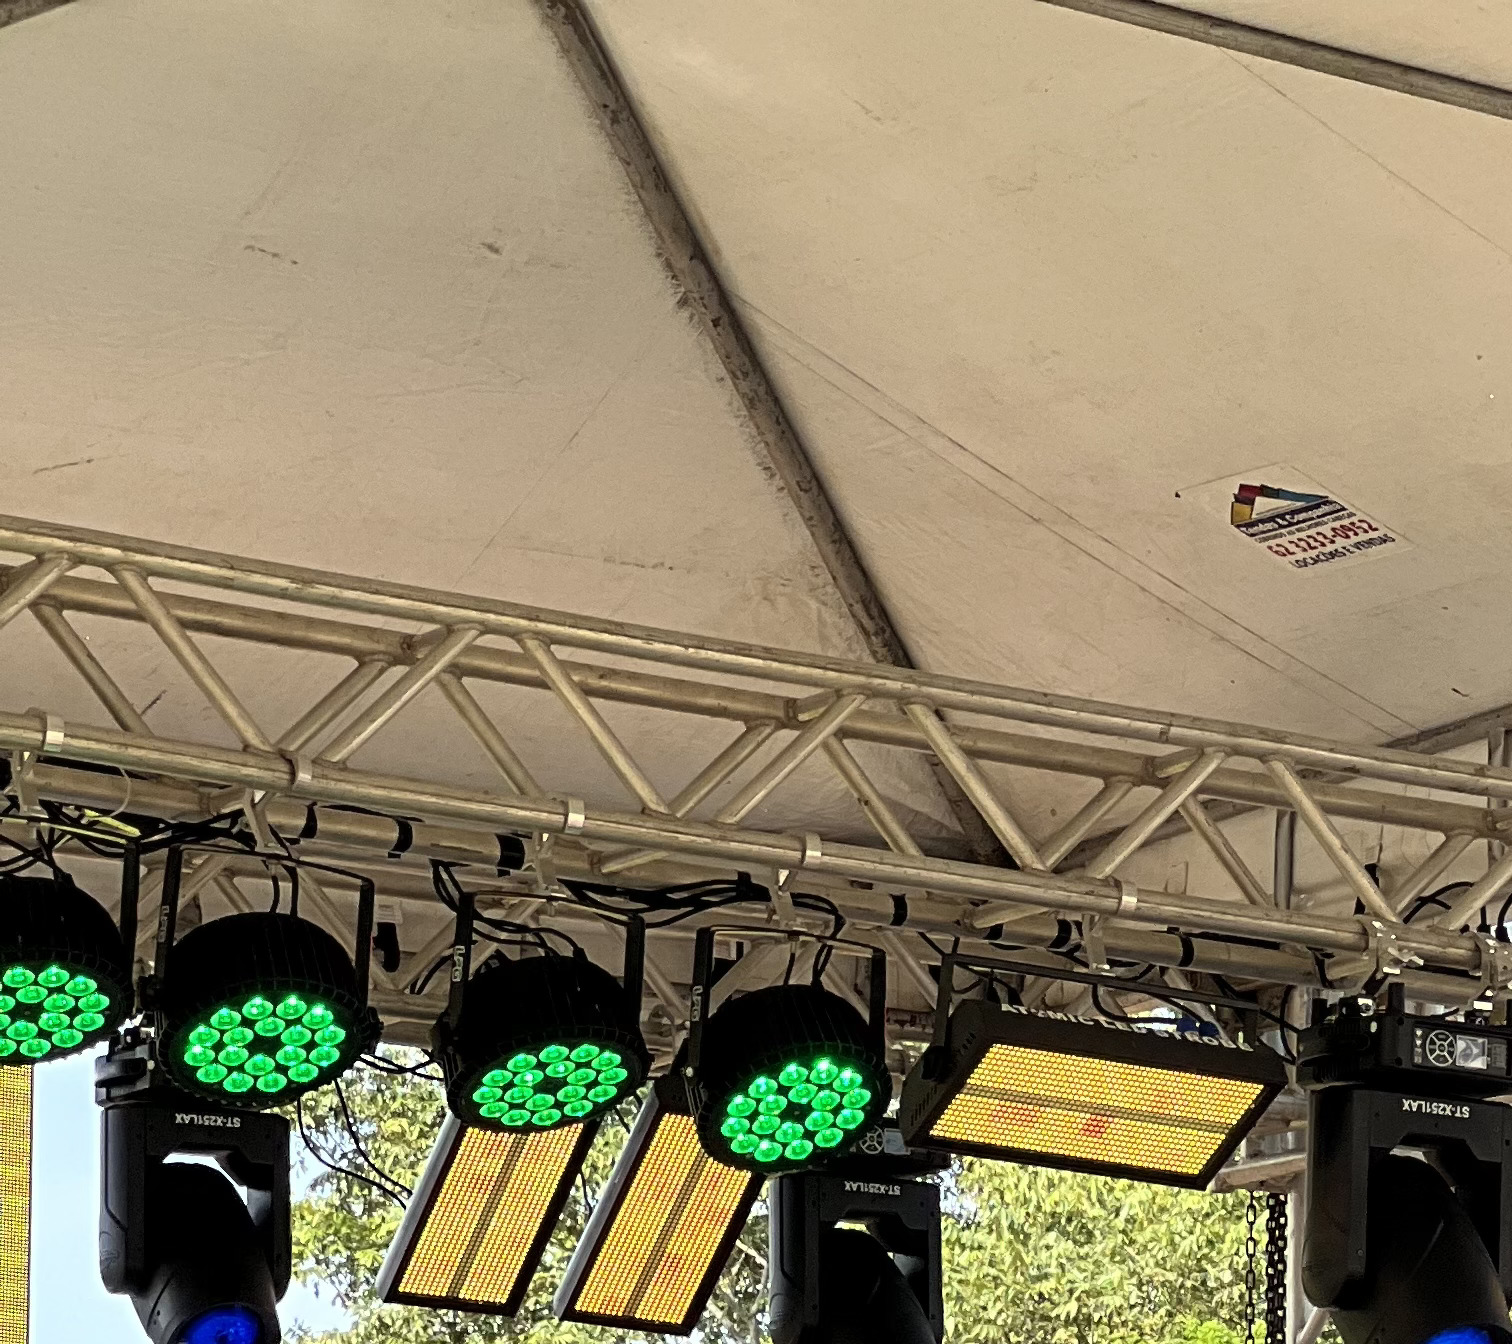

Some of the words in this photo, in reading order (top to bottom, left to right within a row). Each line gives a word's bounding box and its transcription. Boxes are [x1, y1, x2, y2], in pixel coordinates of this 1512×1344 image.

[1267, 542, 1296, 557] 62
[1350, 533, 1396, 551] VENDAS
[1402, 1098, 1471, 1119] ST-X251LAX
[175, 1112, 241, 1128] ST-X251LAX
